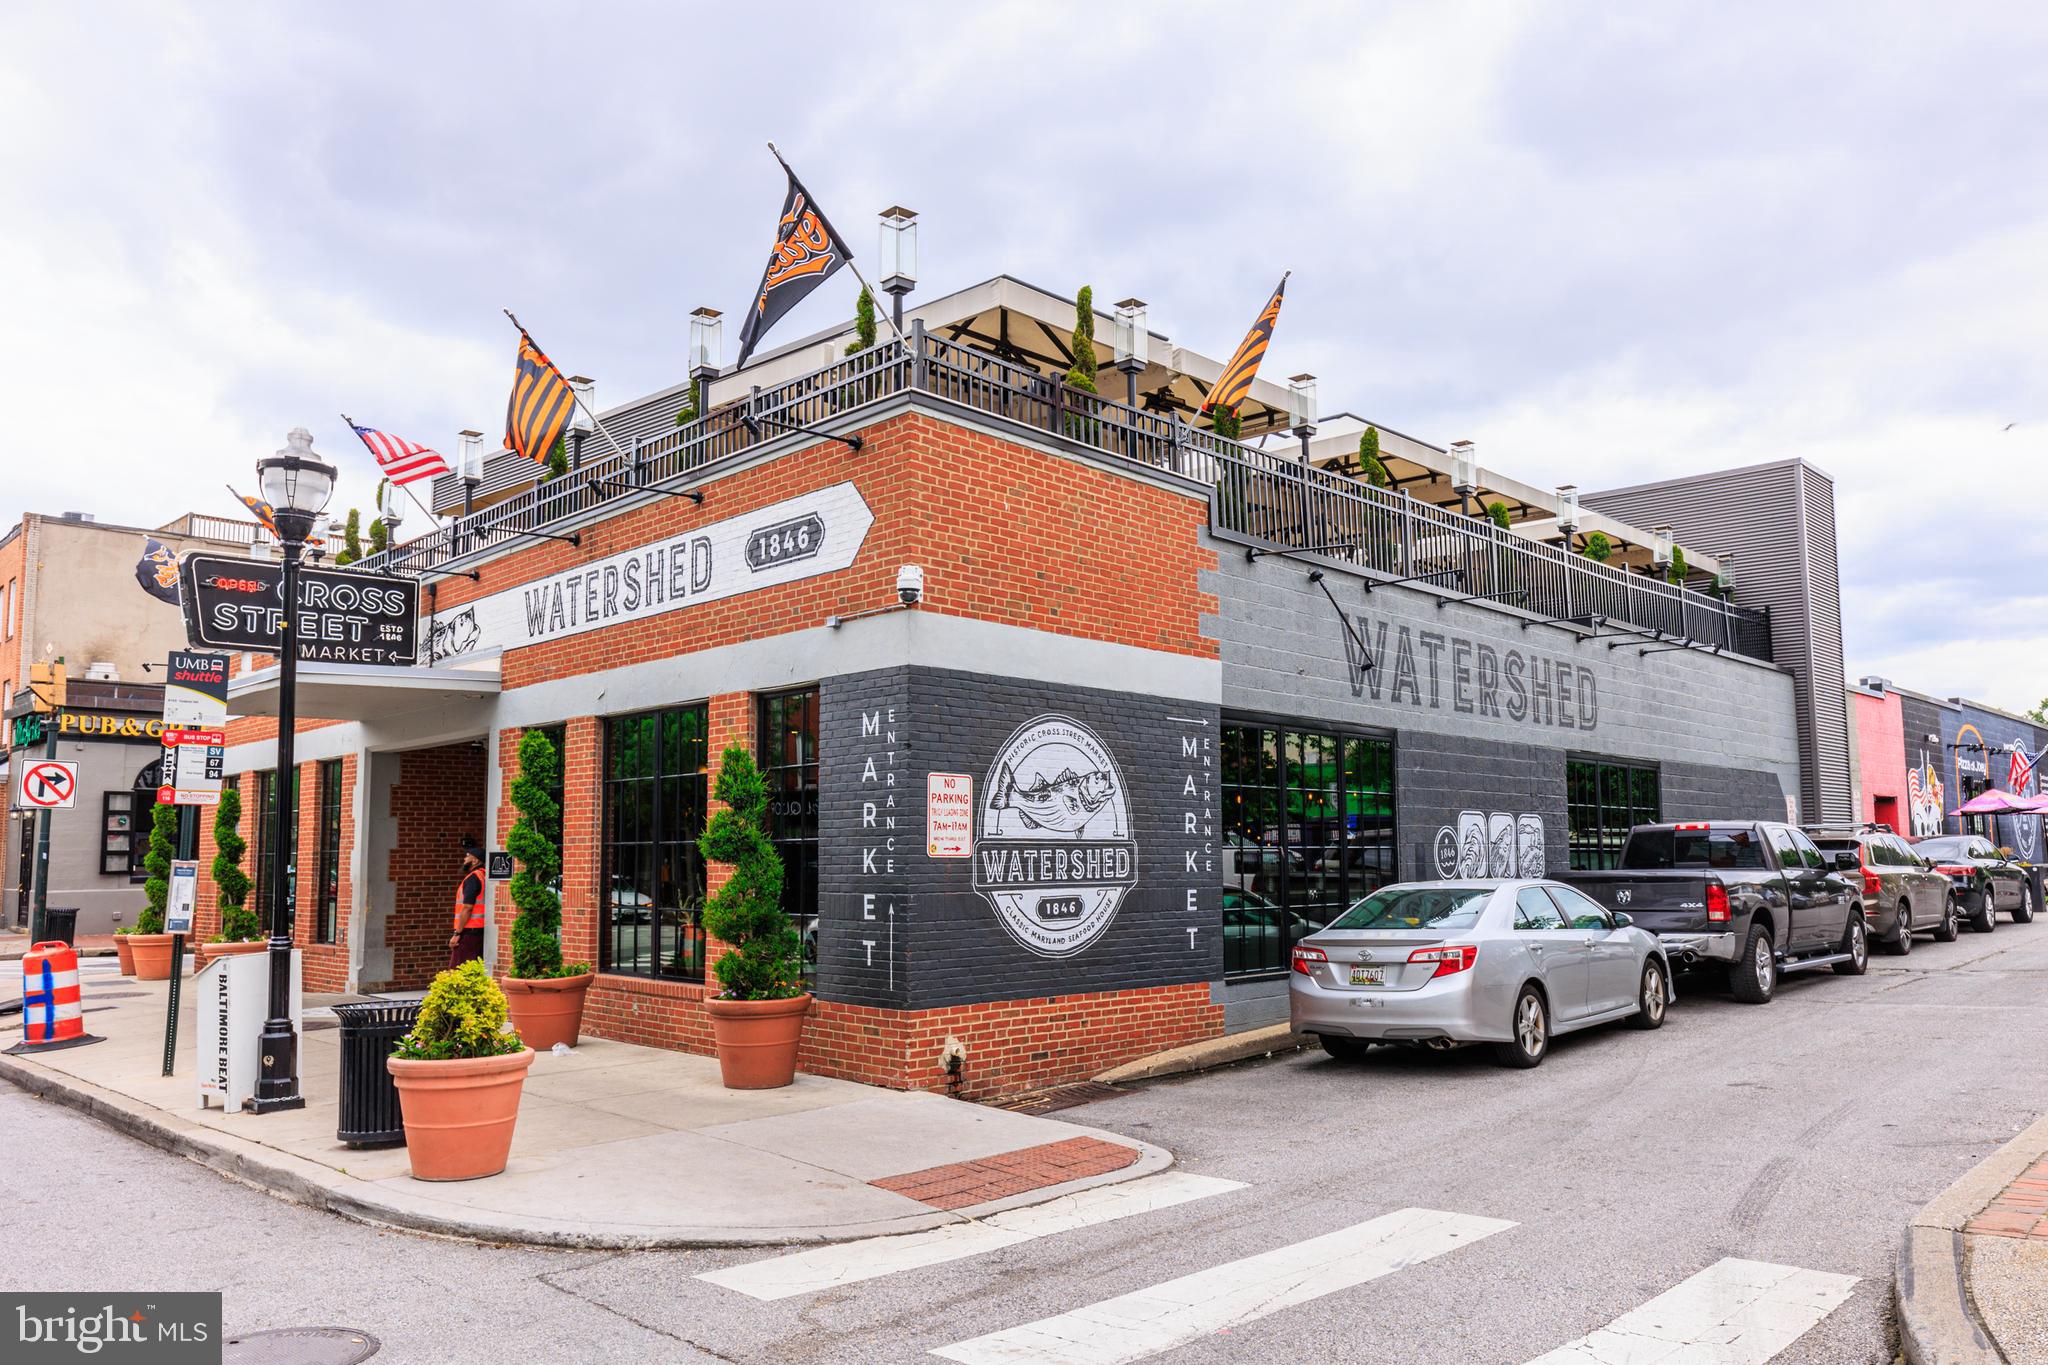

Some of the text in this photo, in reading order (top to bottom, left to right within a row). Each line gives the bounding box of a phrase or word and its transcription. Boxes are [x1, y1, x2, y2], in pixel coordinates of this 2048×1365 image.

[758, 525, 809, 561] 1846
[524, 536, 713, 638] WATERSHED
[175, 657, 209, 670] UMB
[301, 644, 385, 663] MARKET
[174, 670, 223, 684] shuttle
[1339, 612, 1599, 732] WATERSHED
[209, 747, 221, 756] SV
[209, 759, 220, 767] 67
[1007, 728, 1109, 769] HISTORIC CROSS STREET MARKET
[208, 770, 219, 778] 94
[886, 709, 896, 874] ENTRANCE
[944, 778, 956, 789] NO
[931, 792, 969, 805] PARKING
[1203, 737, 1213, 873] ENTRANCE
[862, 711, 881, 967] MARKET
[1182, 736, 1200, 951] MARKET
[1440, 847, 1456, 860] 1846
[982, 847, 1130, 883] WATERSHED
[1005, 897, 1113, 945] CLASSIC MARYLAND SEAFOOD HOUSE
[1045, 901, 1076, 915] 1846
[218, 974, 228, 1055] BALTIMORE
[218, 1057, 228, 1094] BEAT
